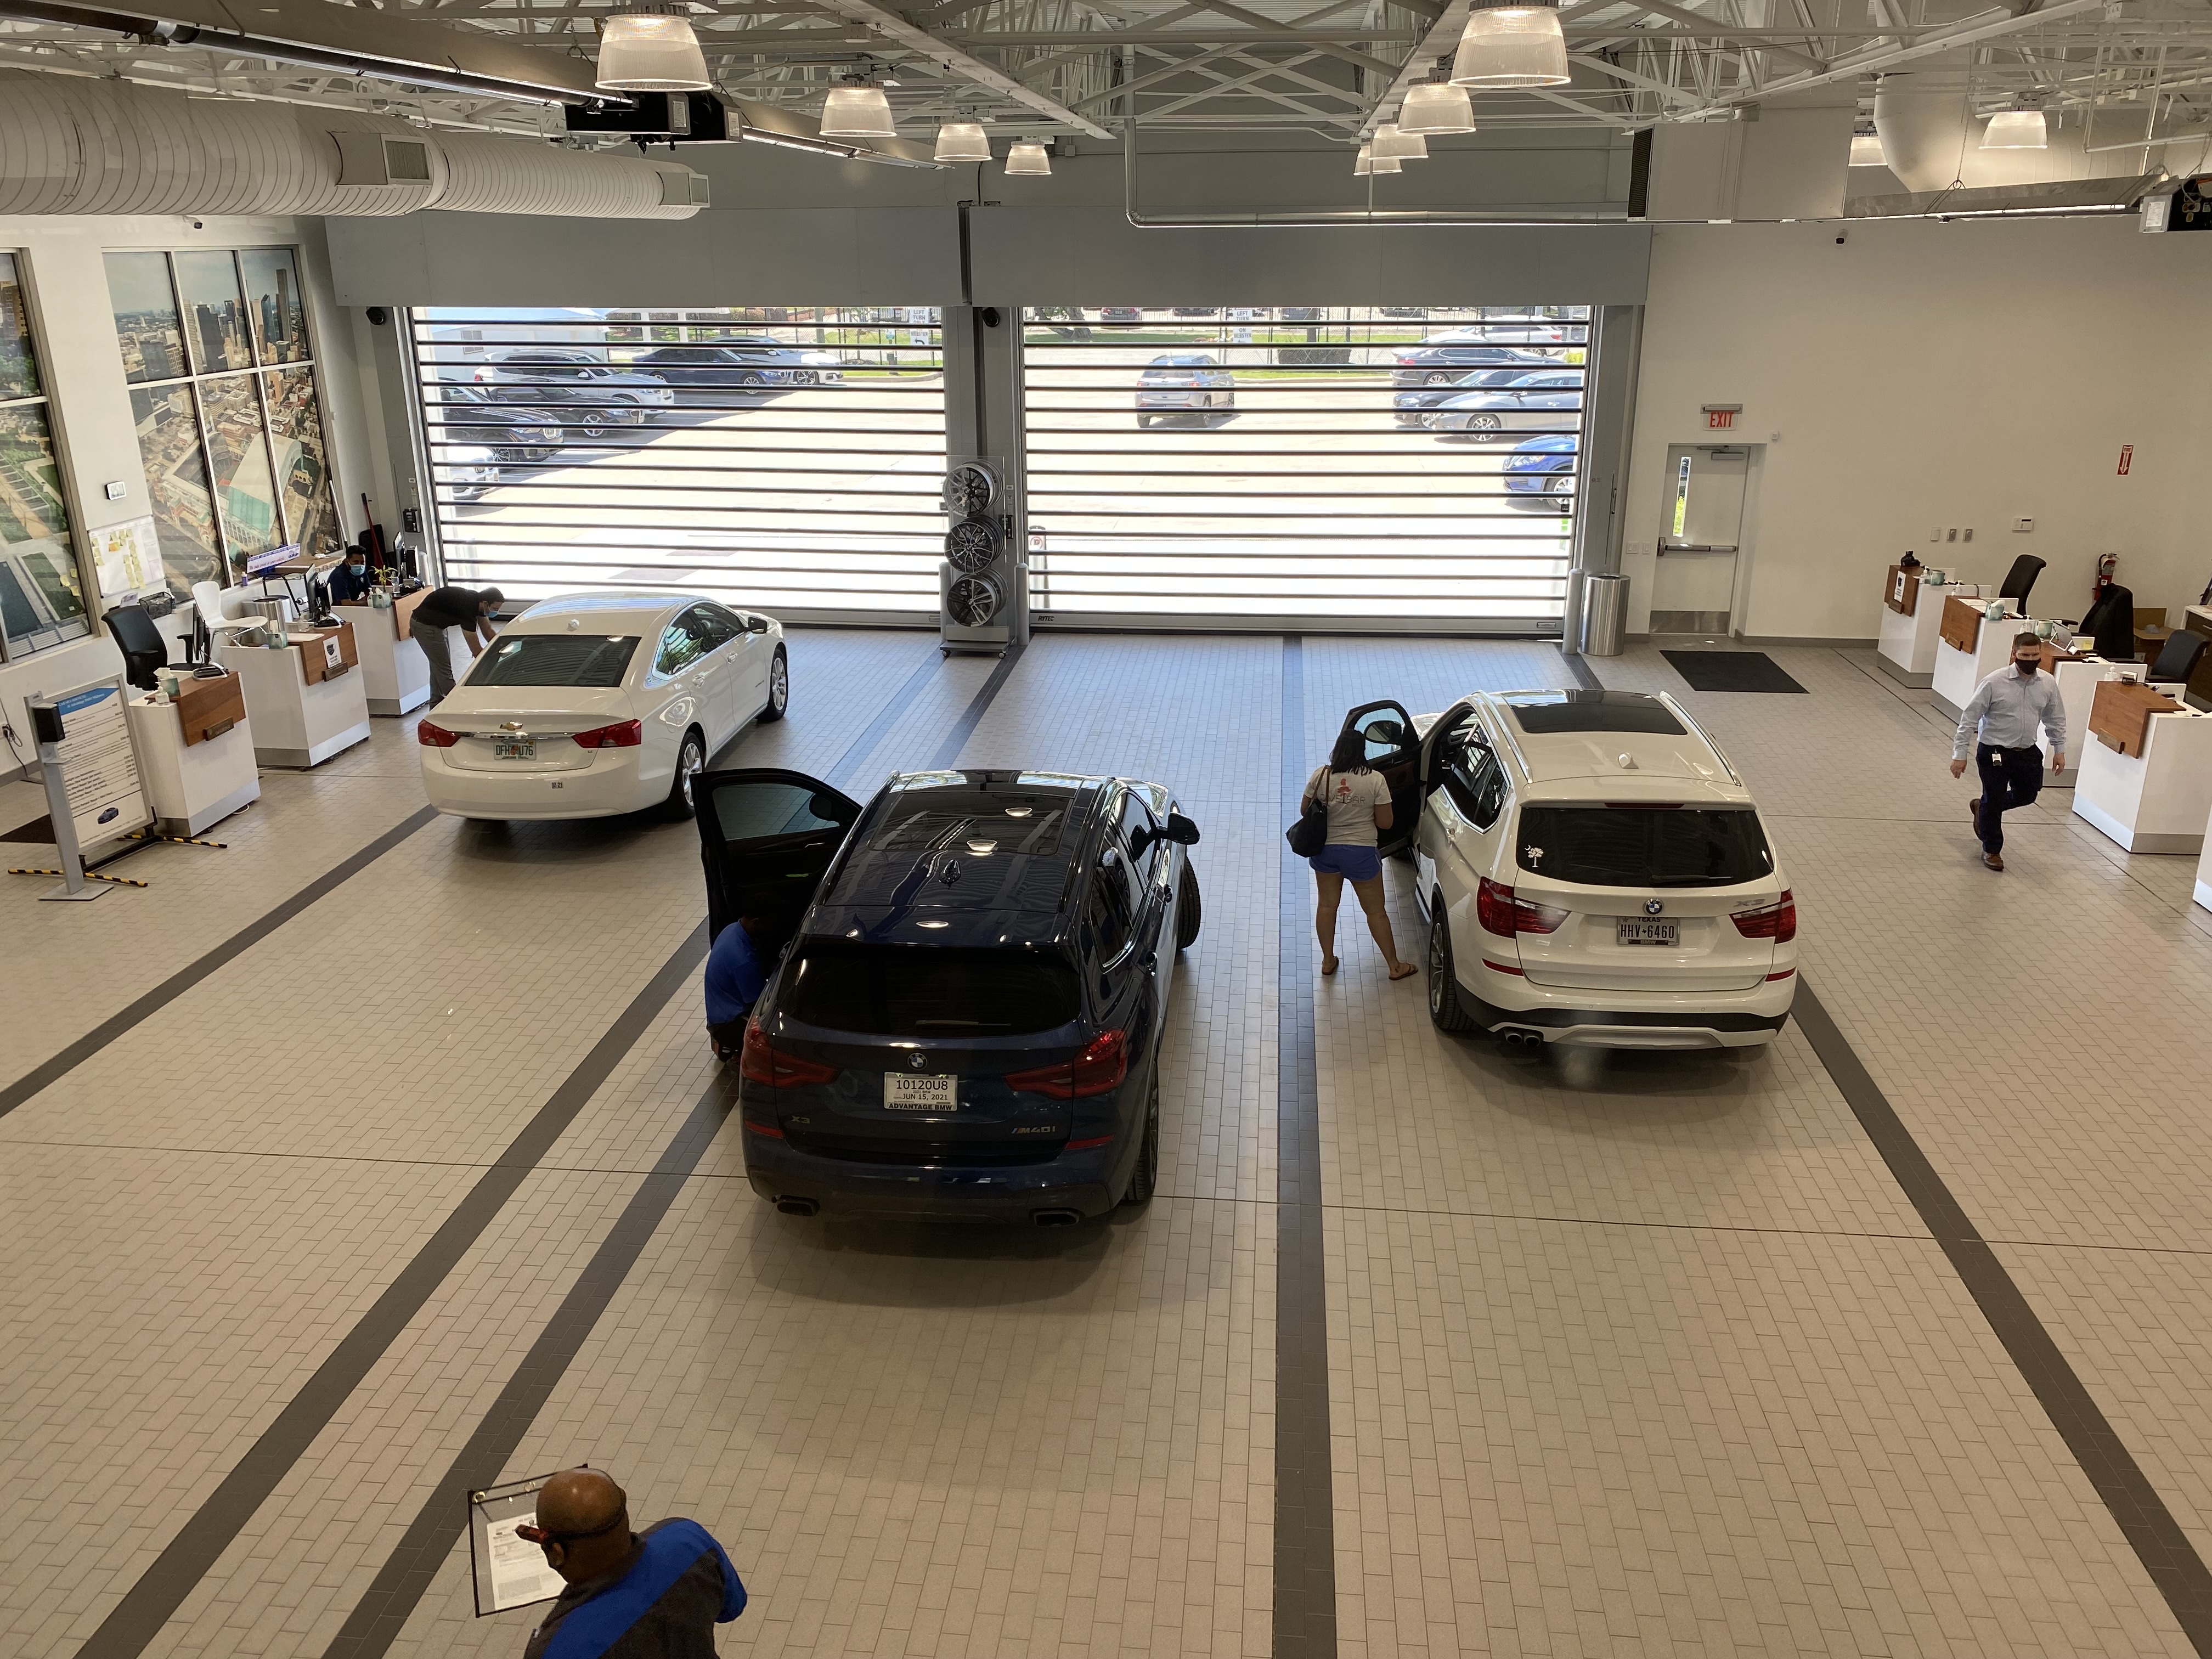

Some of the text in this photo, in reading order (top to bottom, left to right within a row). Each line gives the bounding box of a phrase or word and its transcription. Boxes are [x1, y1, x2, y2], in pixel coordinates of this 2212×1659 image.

[1709, 411, 1734, 427] EXIT
[496, 745, 533, 756] DFH U76
[1321, 794, 1365, 804] DVE BAR
[1621, 924, 1674, 939] HHV 6460
[896, 1080, 948, 1090] 10120U8
[791, 1115, 810, 1124] X3
